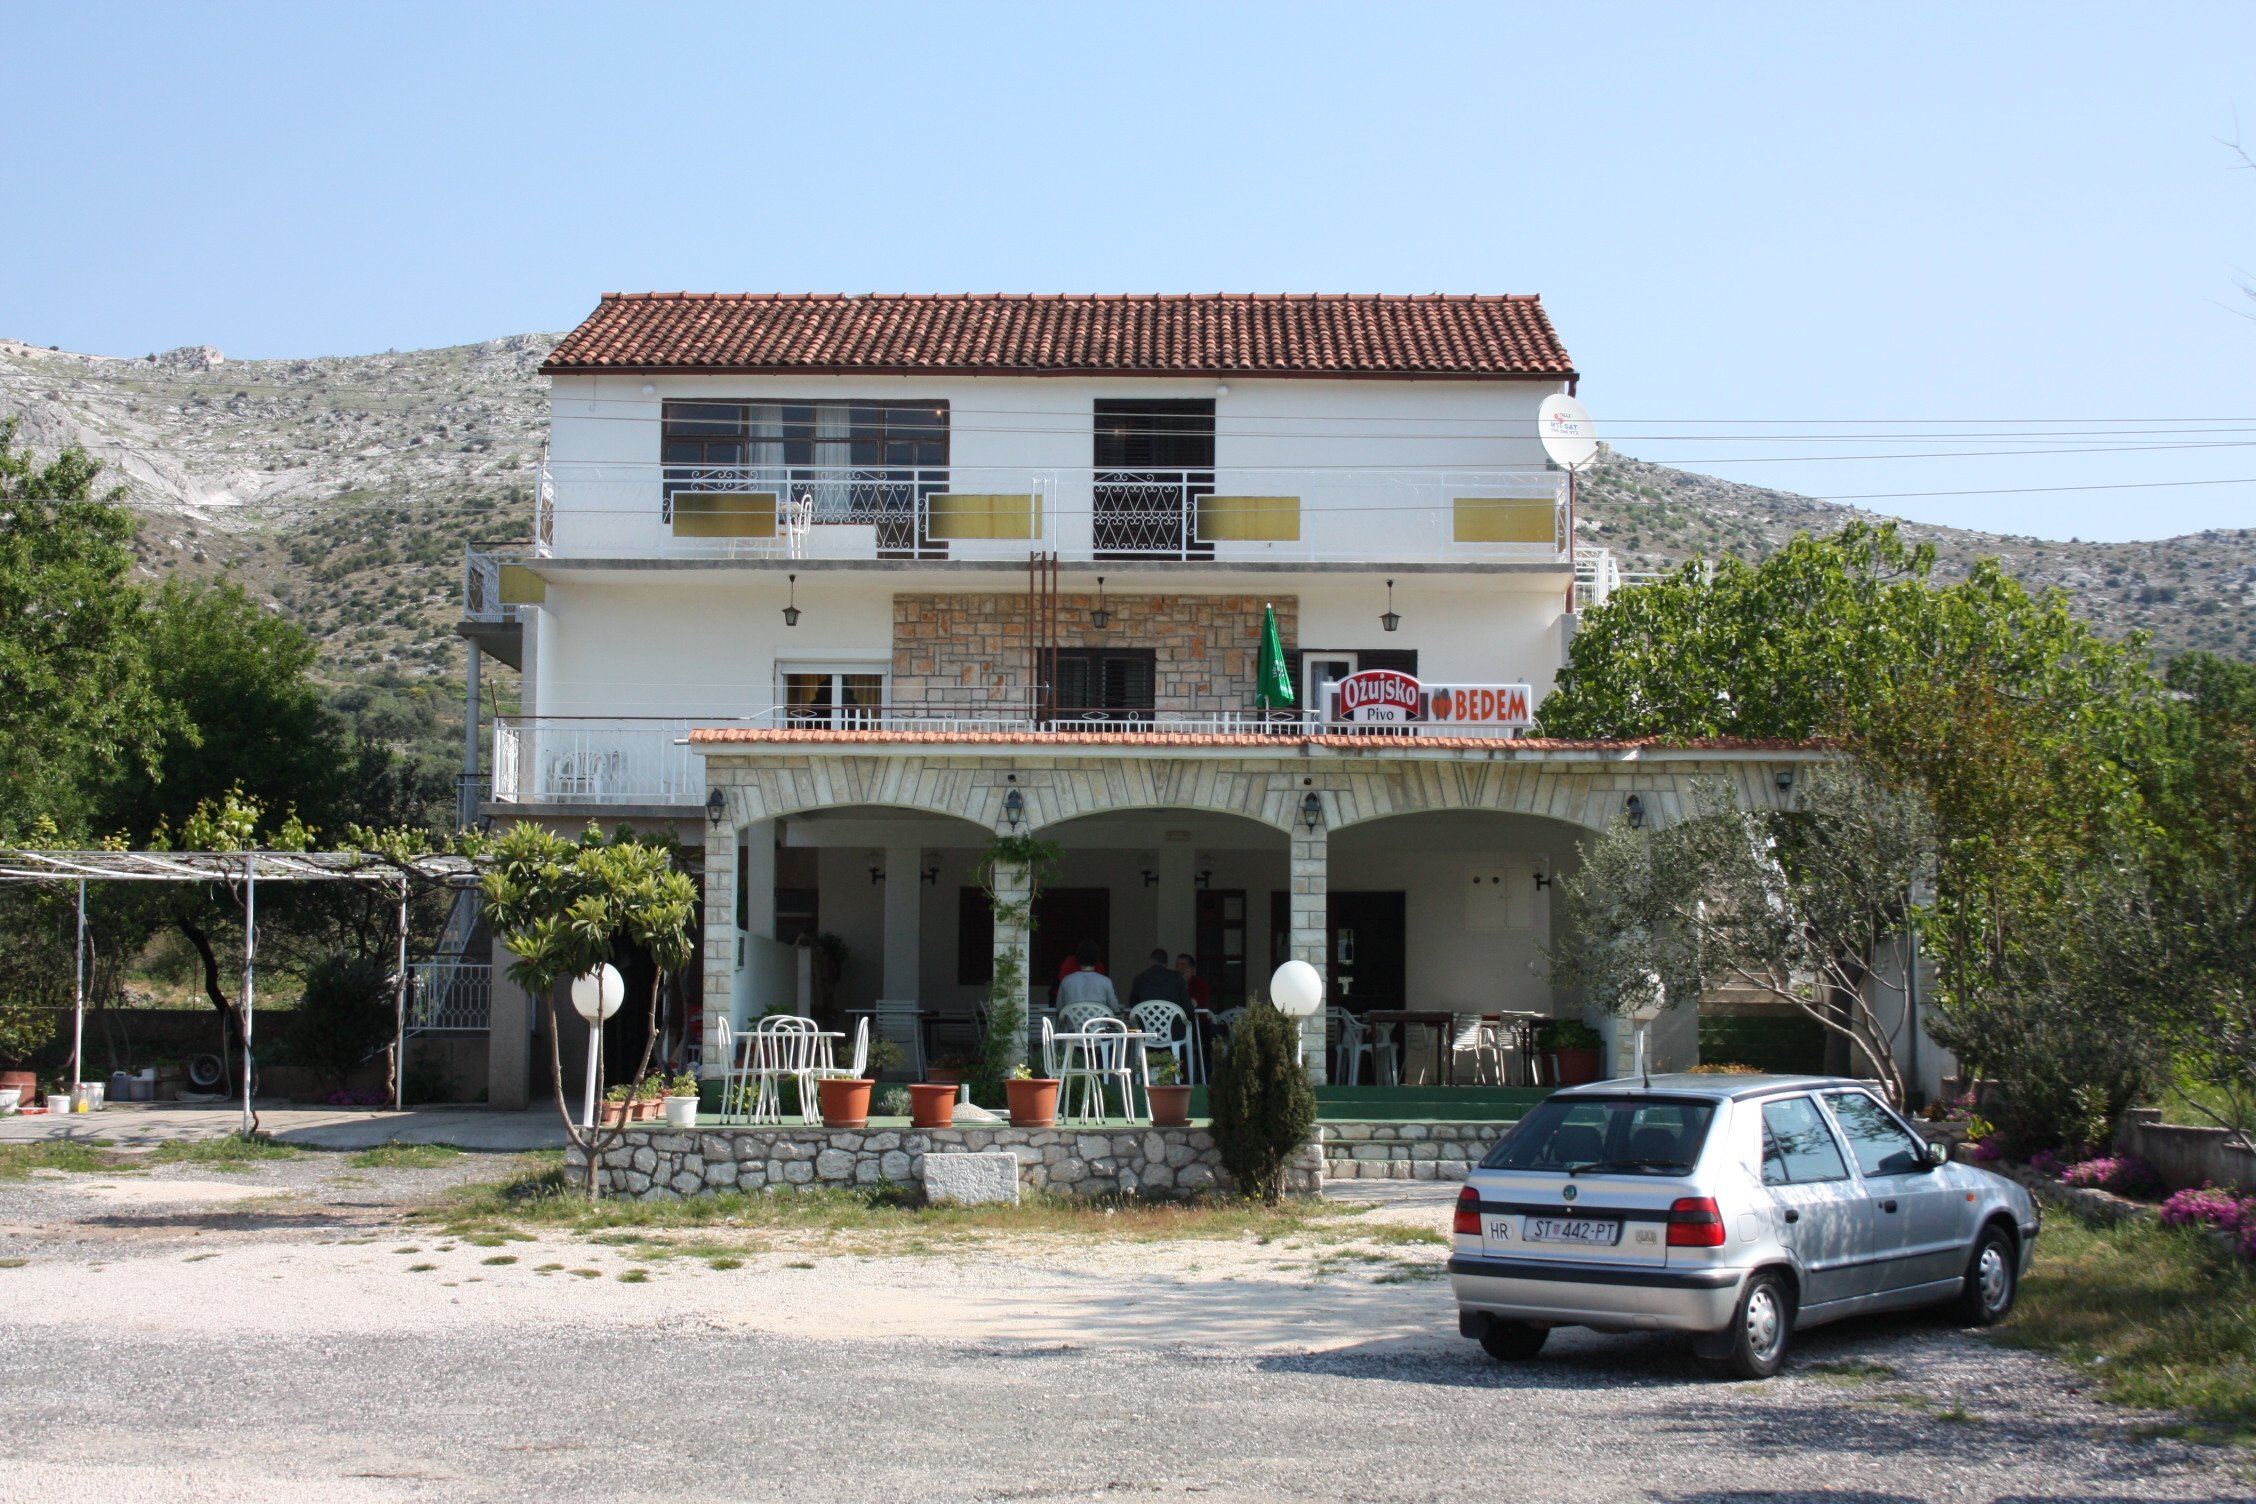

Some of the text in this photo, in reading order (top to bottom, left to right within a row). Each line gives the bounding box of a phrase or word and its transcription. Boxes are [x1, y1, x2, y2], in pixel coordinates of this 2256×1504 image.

[1345, 673, 1417, 708] Ožujsko
[1367, 707, 1394, 721] Pivo
[1455, 689, 1528, 721] BEDEM
[1491, 1222, 1510, 1240] HR
[1534, 1220, 1553, 1237] ST
